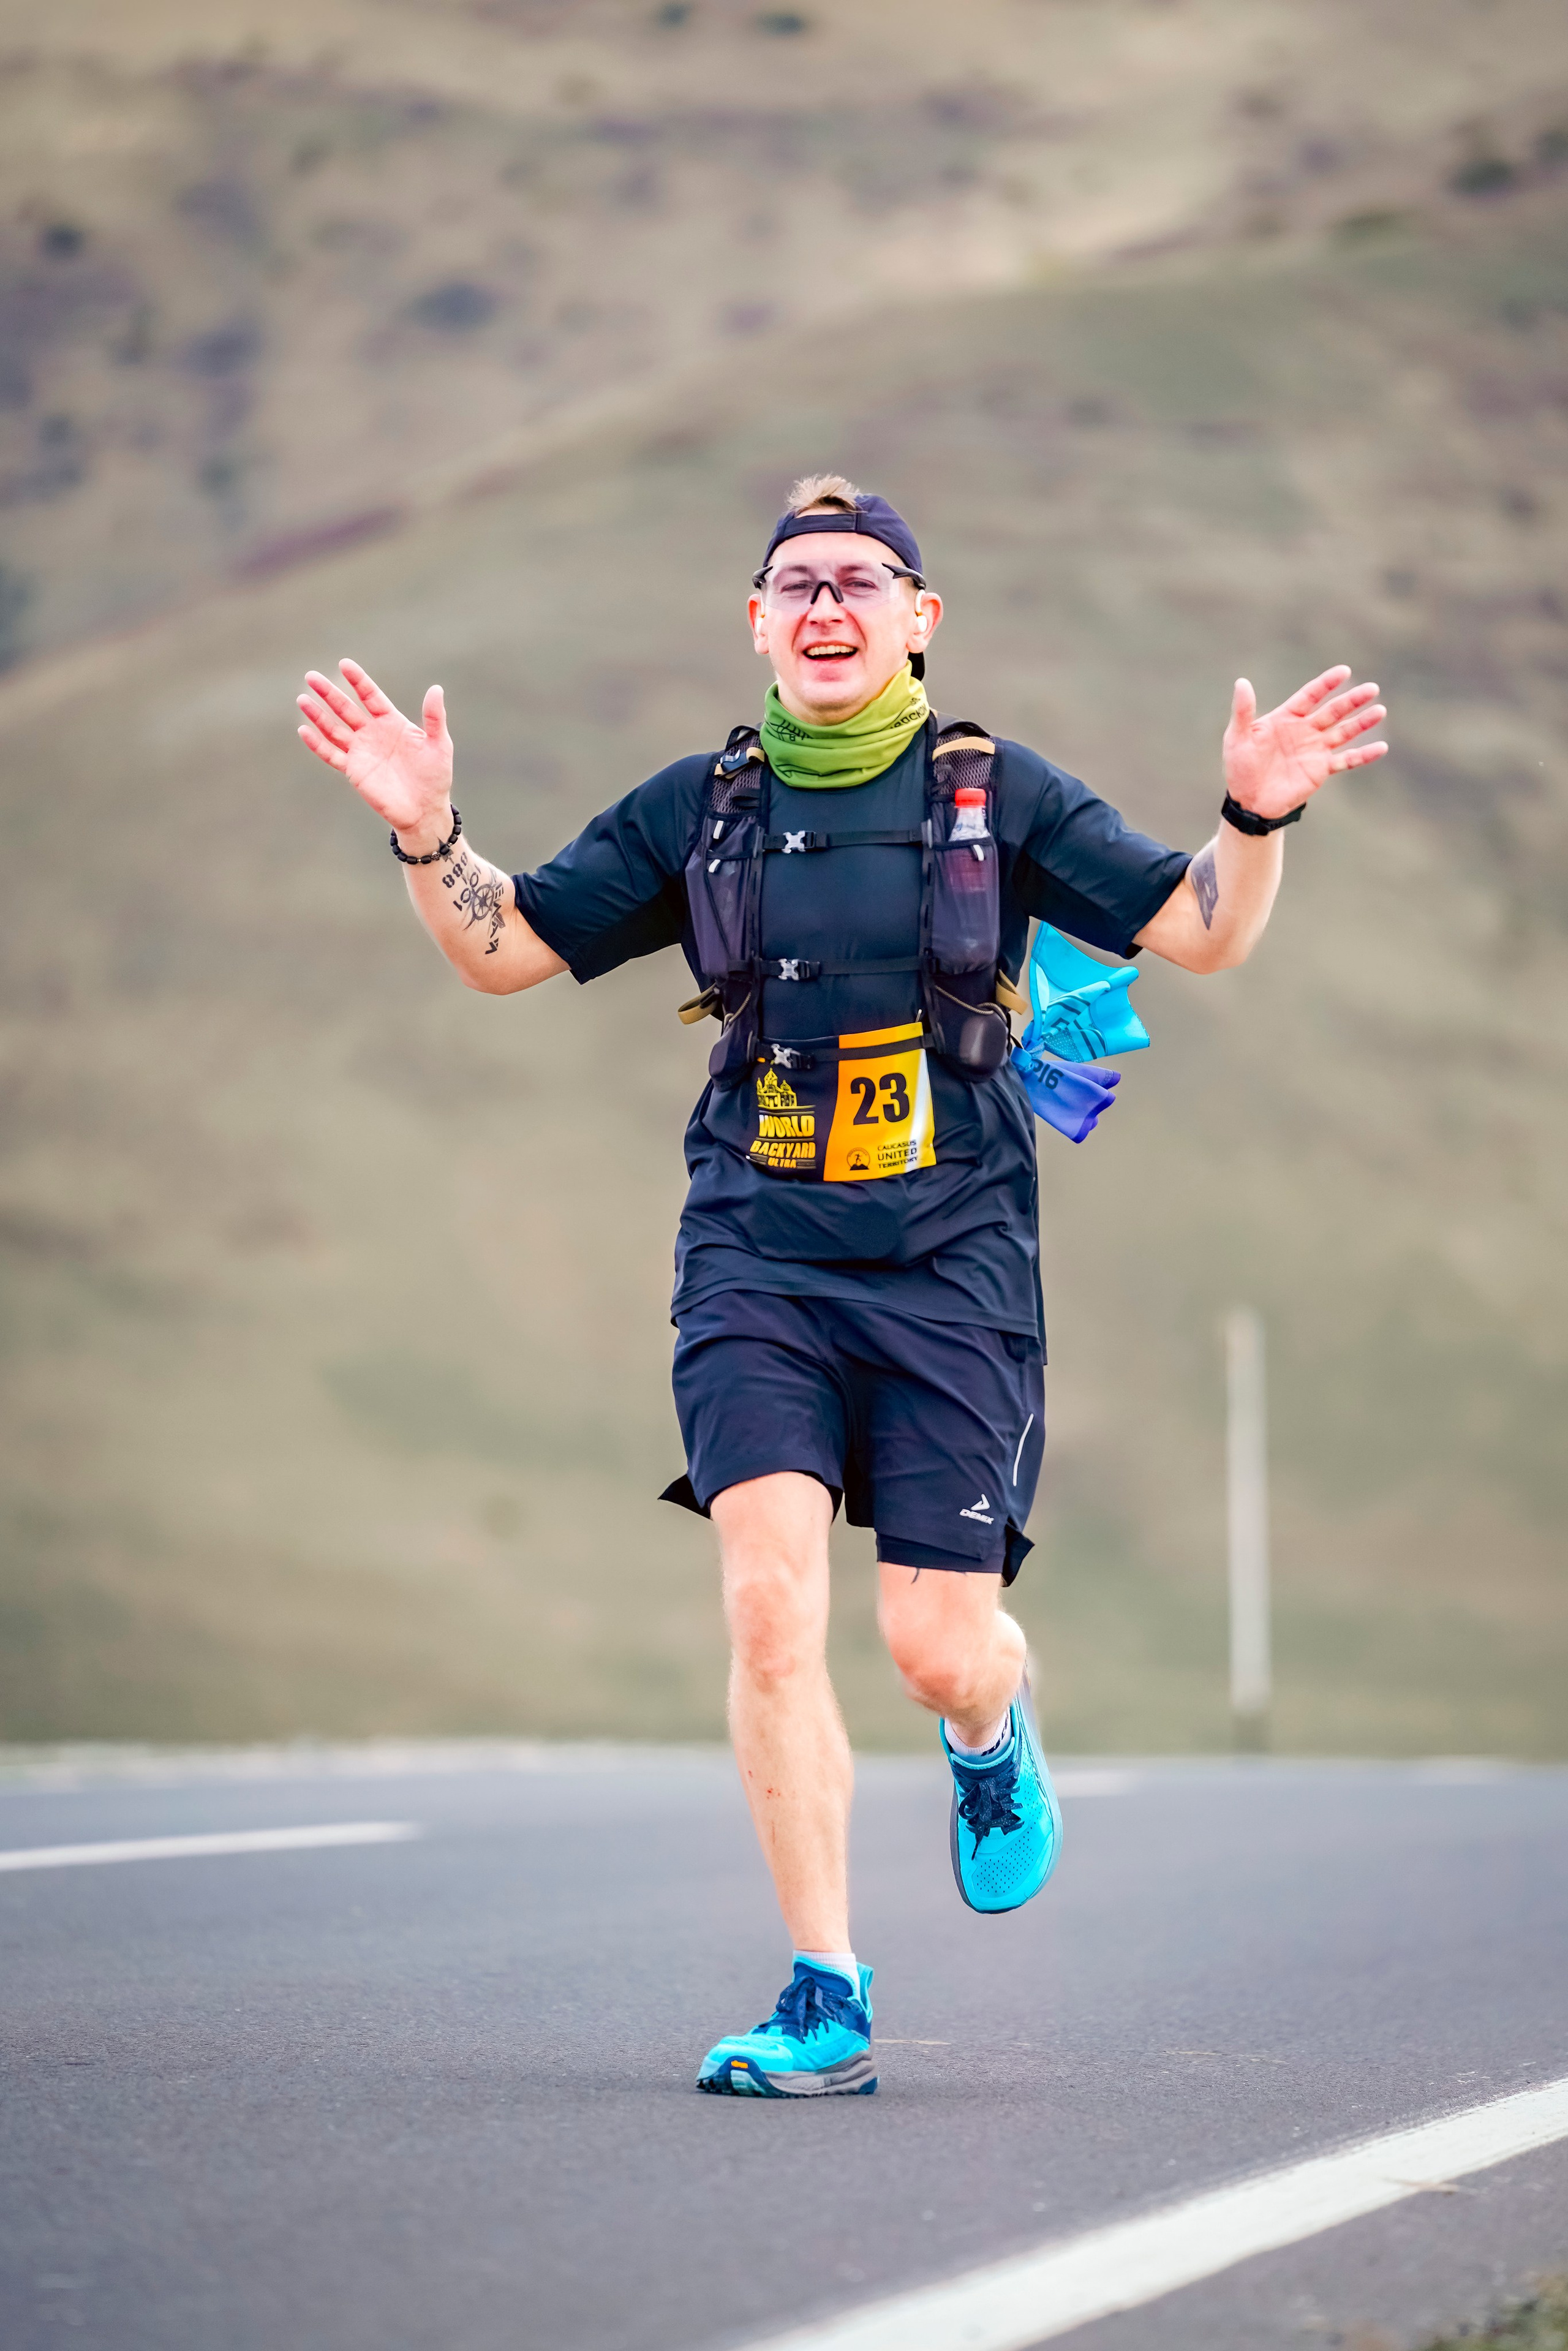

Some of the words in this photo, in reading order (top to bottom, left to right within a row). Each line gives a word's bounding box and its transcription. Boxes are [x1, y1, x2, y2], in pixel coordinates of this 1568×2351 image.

[850, 1073, 910, 1125] 23
[759, 1114, 815, 1138] WORLD
[750, 1140, 816, 1158] BACKYARD
[877, 1140, 916, 1151] CAUCASUS
[878, 1147, 917, 1161] UNITED
[767, 1157, 797, 1169] ULTRA
[878, 1157, 918, 1168] TERRITORY
